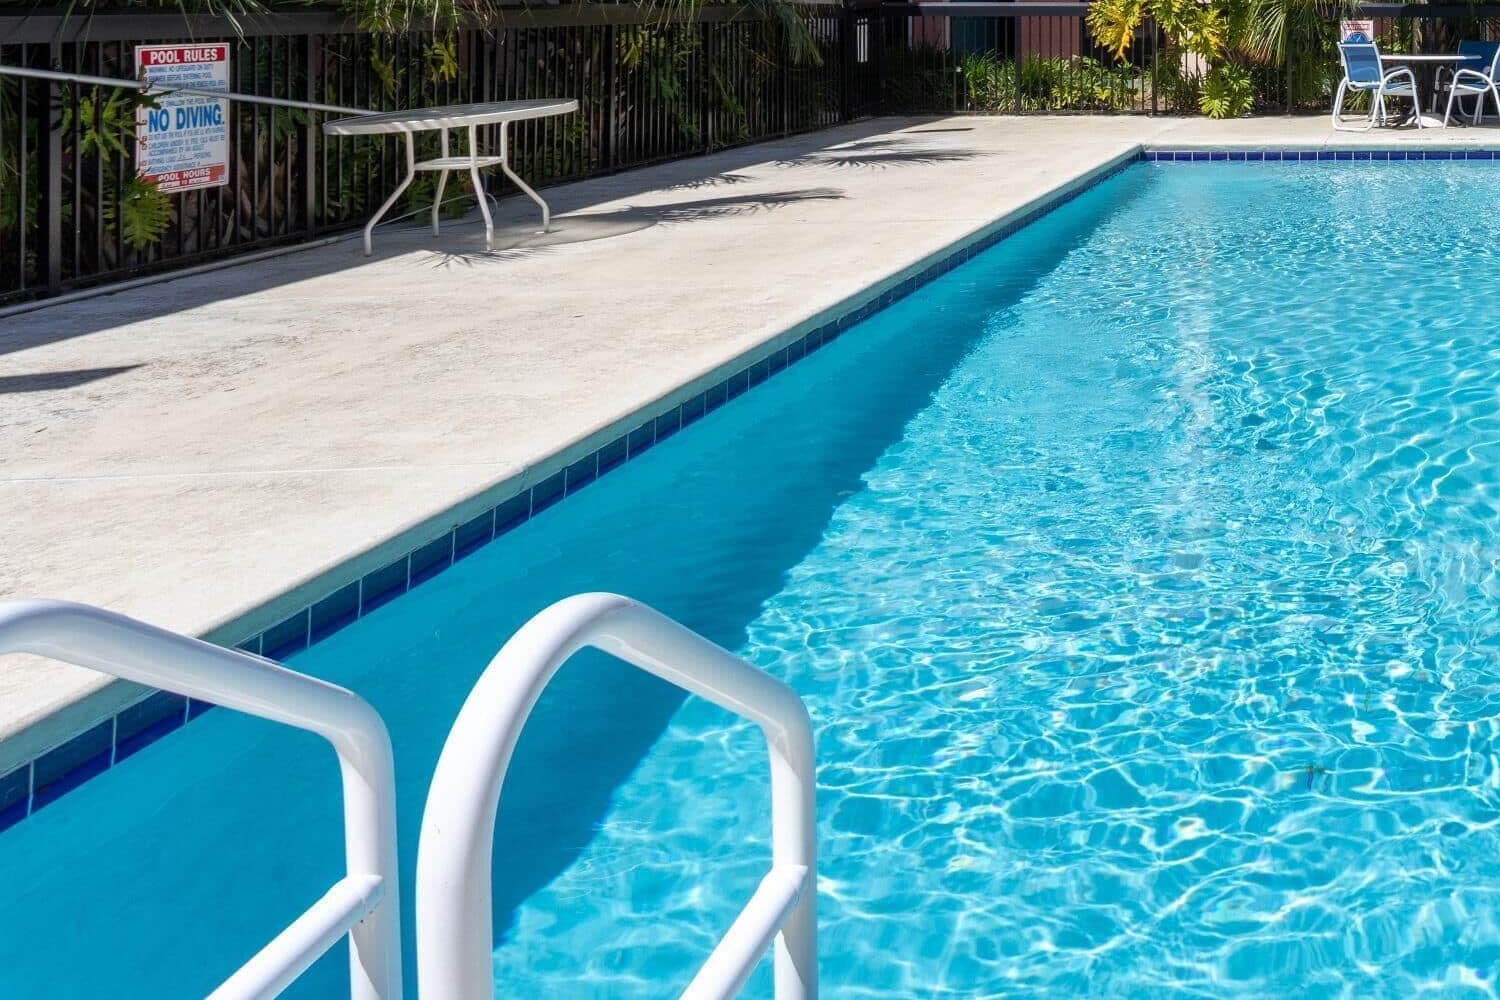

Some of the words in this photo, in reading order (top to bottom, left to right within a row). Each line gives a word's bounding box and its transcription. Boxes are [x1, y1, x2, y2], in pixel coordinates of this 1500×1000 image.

[150, 50, 180, 64] POOL
[184, 49, 218, 62] RULES
[148, 110, 170, 133] NO
[176, 103, 225, 130] DIVING.
[158, 172, 180, 182] POOL
[183, 167, 211, 180] HOURS
